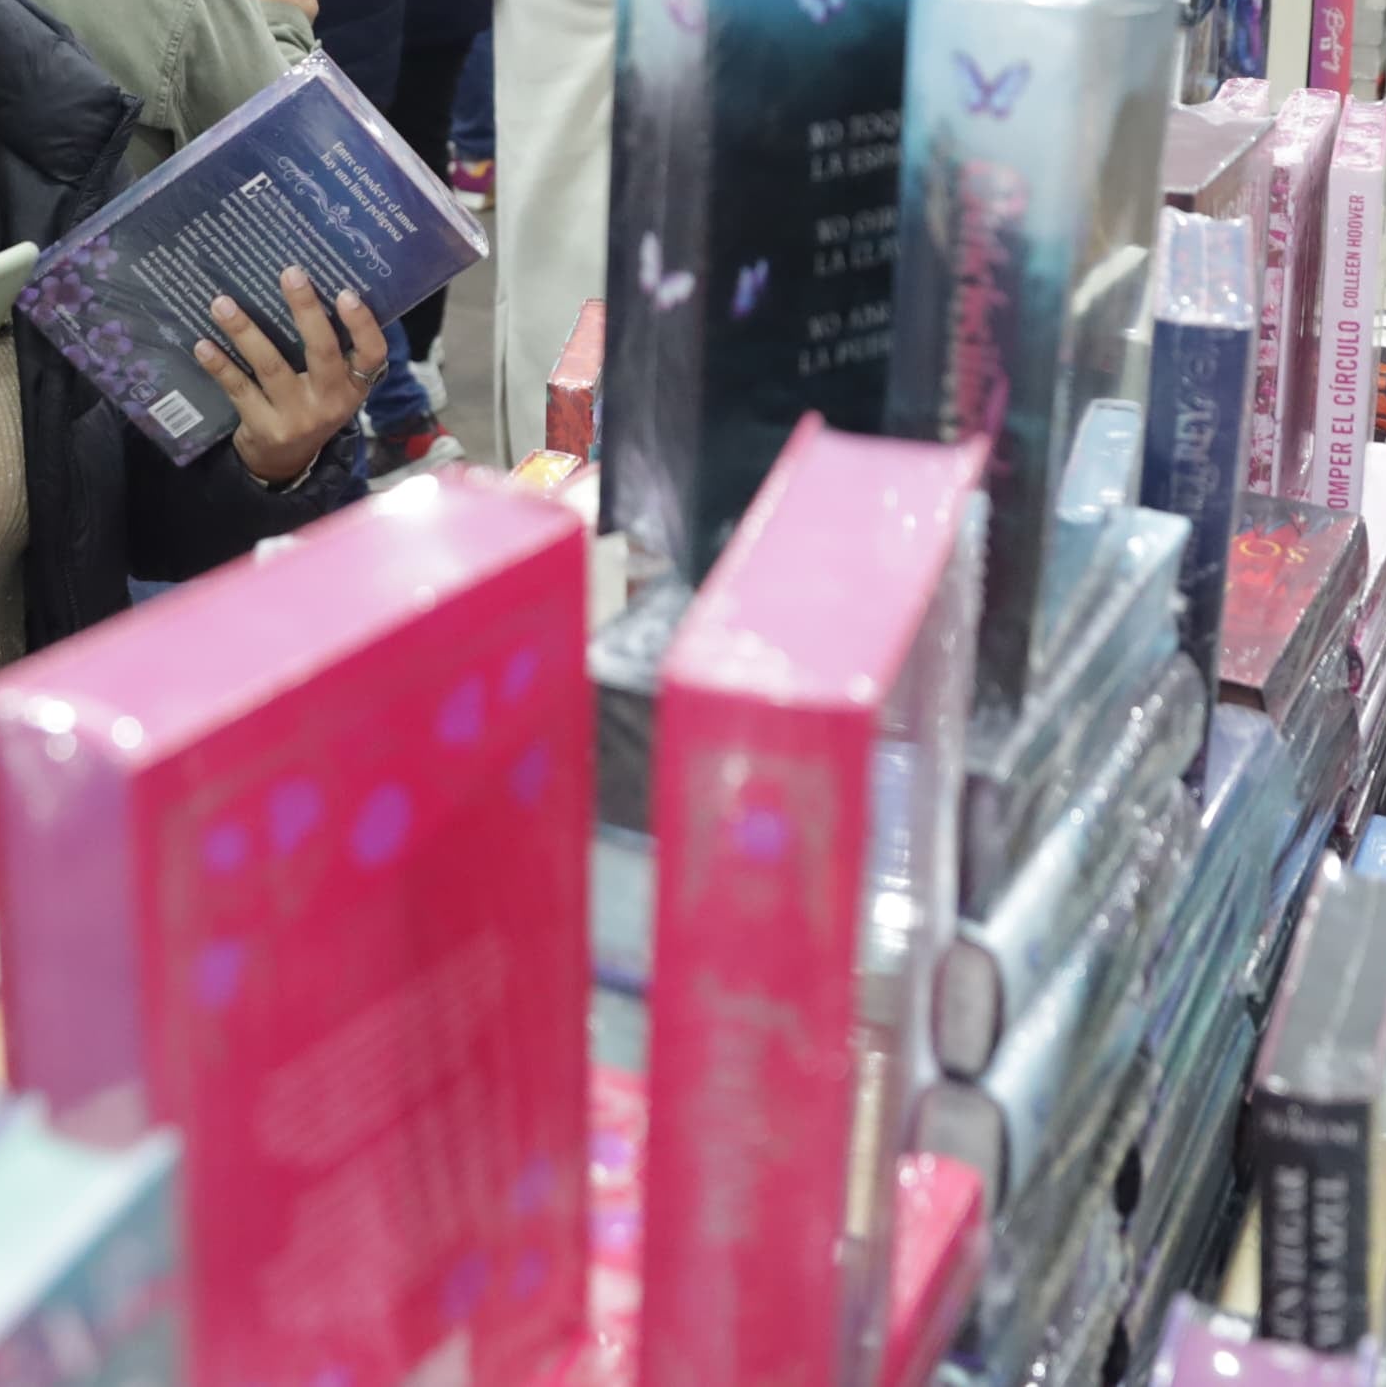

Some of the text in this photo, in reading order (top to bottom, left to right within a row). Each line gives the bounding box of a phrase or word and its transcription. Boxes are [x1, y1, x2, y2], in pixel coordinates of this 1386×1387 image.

[332, 140, 358, 168] Entre
[352, 162, 366, 176] el
[318, 151, 404, 244] hay una línea peligrosa
[358, 171, 387, 201] poder
[386, 200, 400, 214] el
[393, 209, 418, 235] amor
[1343, 194, 1365, 309] COLLEEN HOOVER
[1327, 319, 1361, 510] OMPER EL CÍRCULO
